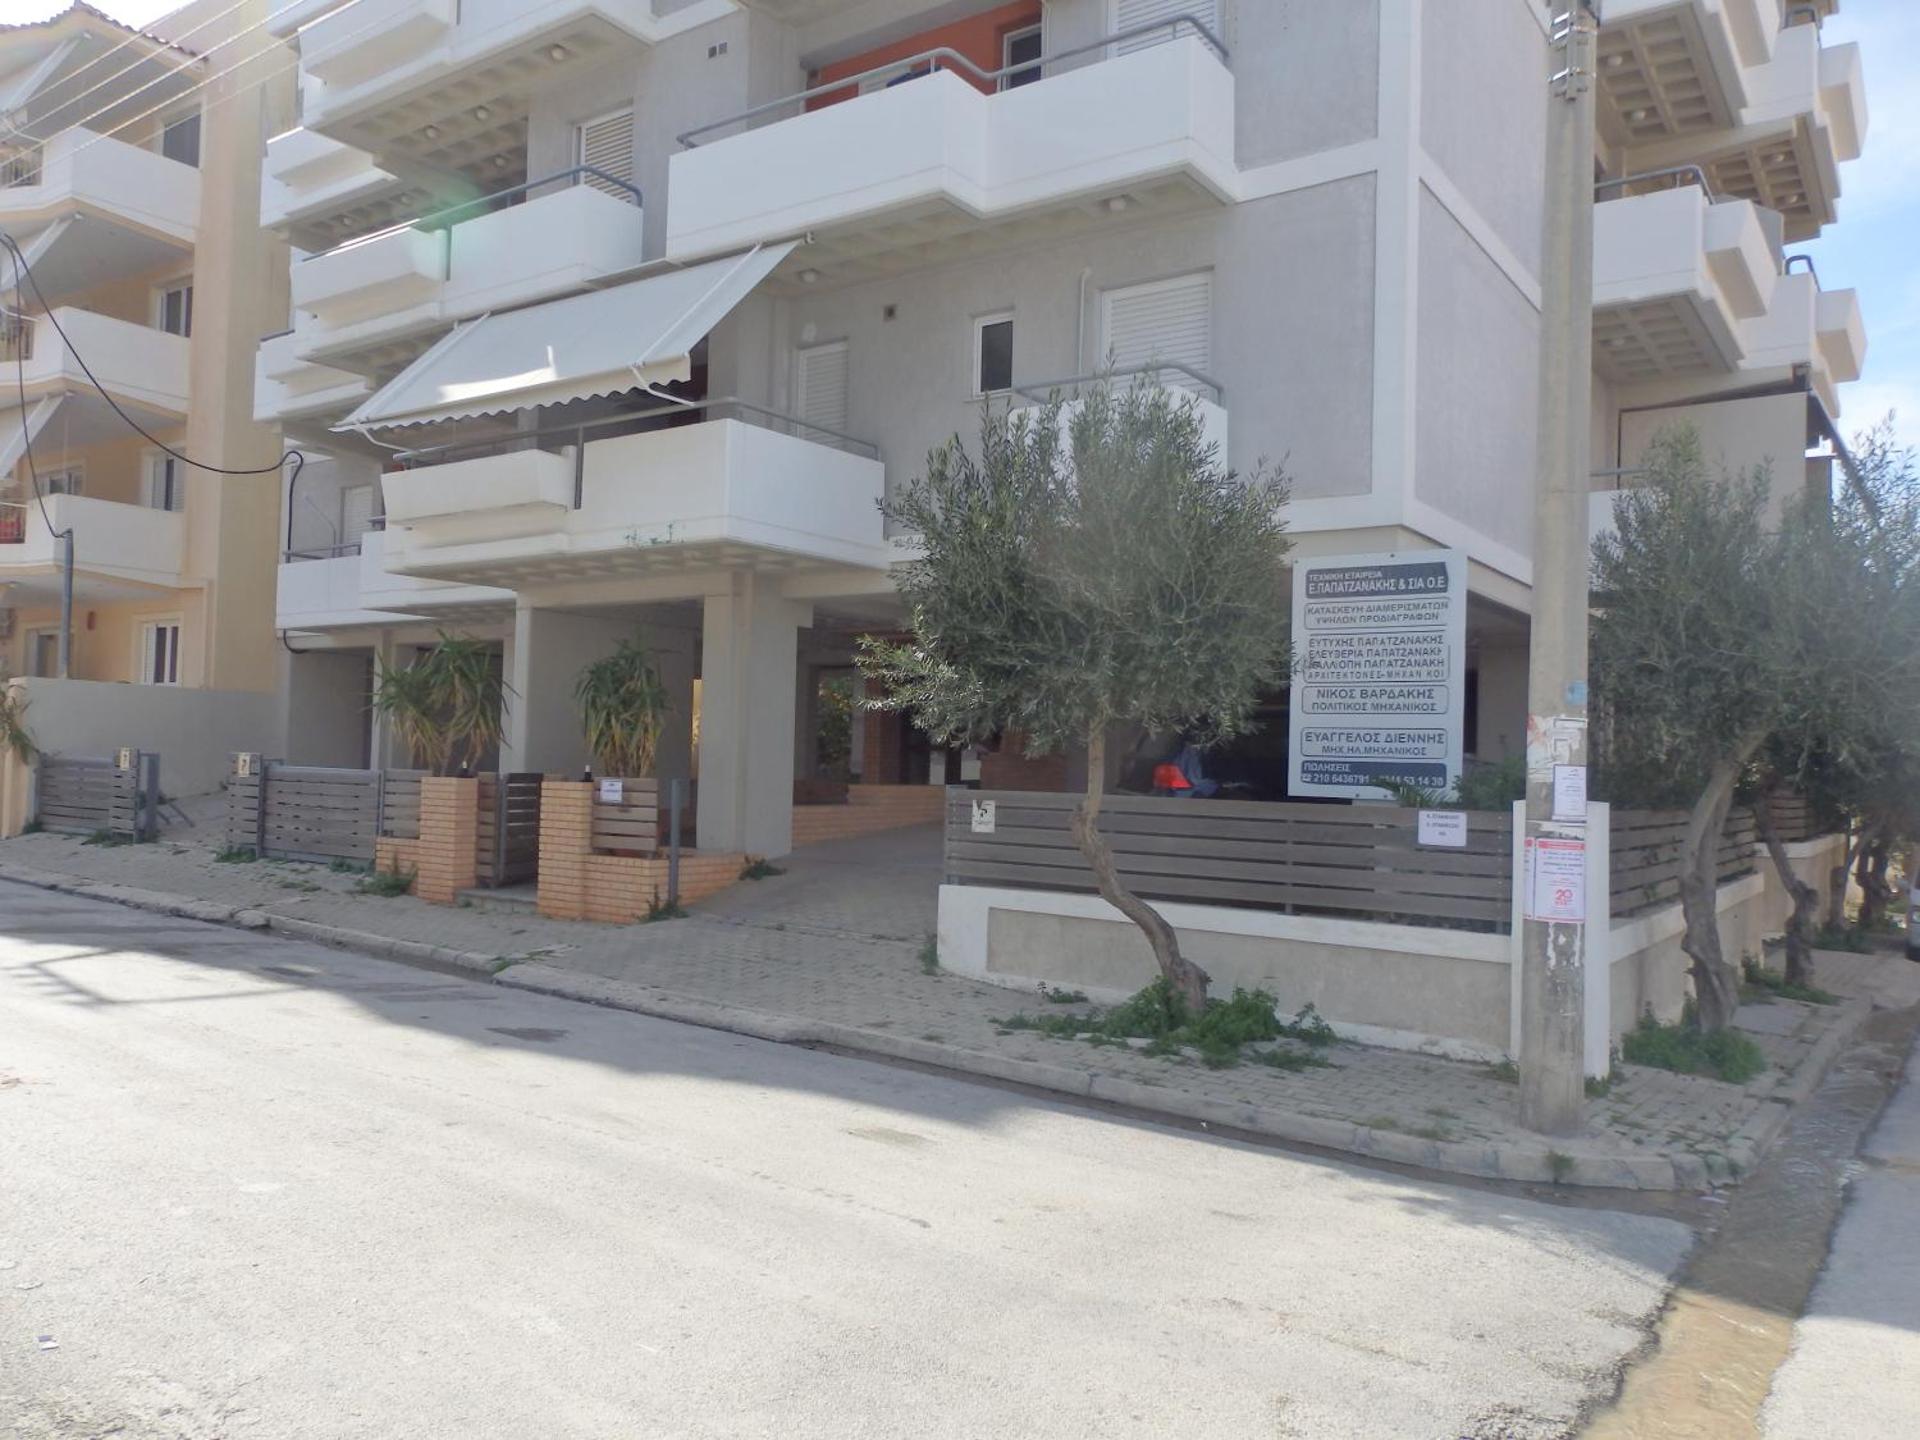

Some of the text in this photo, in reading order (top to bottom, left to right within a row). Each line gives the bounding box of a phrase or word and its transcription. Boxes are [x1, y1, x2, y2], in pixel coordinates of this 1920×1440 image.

[1398, 579, 1407, 590] &
[1408, 577, 1425, 590] ΣΙΑ
[1308, 601, 1448, 615] ΚΑΤΑΣΚΕΥΗ ΔΙΑΜΕΡΙΣΜΑΤΩΝ
[1316, 612, 1439, 624] ΥΨΗΛΩΝ ΠΡΟΔΙΑΓΡΑΦΩΝ
[1309, 635, 1444, 648] ΕΥΤΥΧΗΣ ΠΑΠΑΤΖΑΝΑΚΗΣ
[1309, 649, 1363, 659] ΕΛΕΥΘΕΡΙΑ
[1309, 658, 1444, 670] ΑΛΛΙΟΠΗ ΠΑΠΑΤΖΑΝΑΚΗ
[1316, 688, 1434, 699] ΝΙΚΟΣ ΒΑΡΔΑΚΗΣ
[1312, 702, 1437, 712] ΠΟΛΙΤΙΚΟΣ ΜΗΧΑΝΙΚΟΣ
[1305, 732, 1445, 745] ΕΥΑΓΓΕΛΟΣ ΔΙΕΝΝΗΣ
